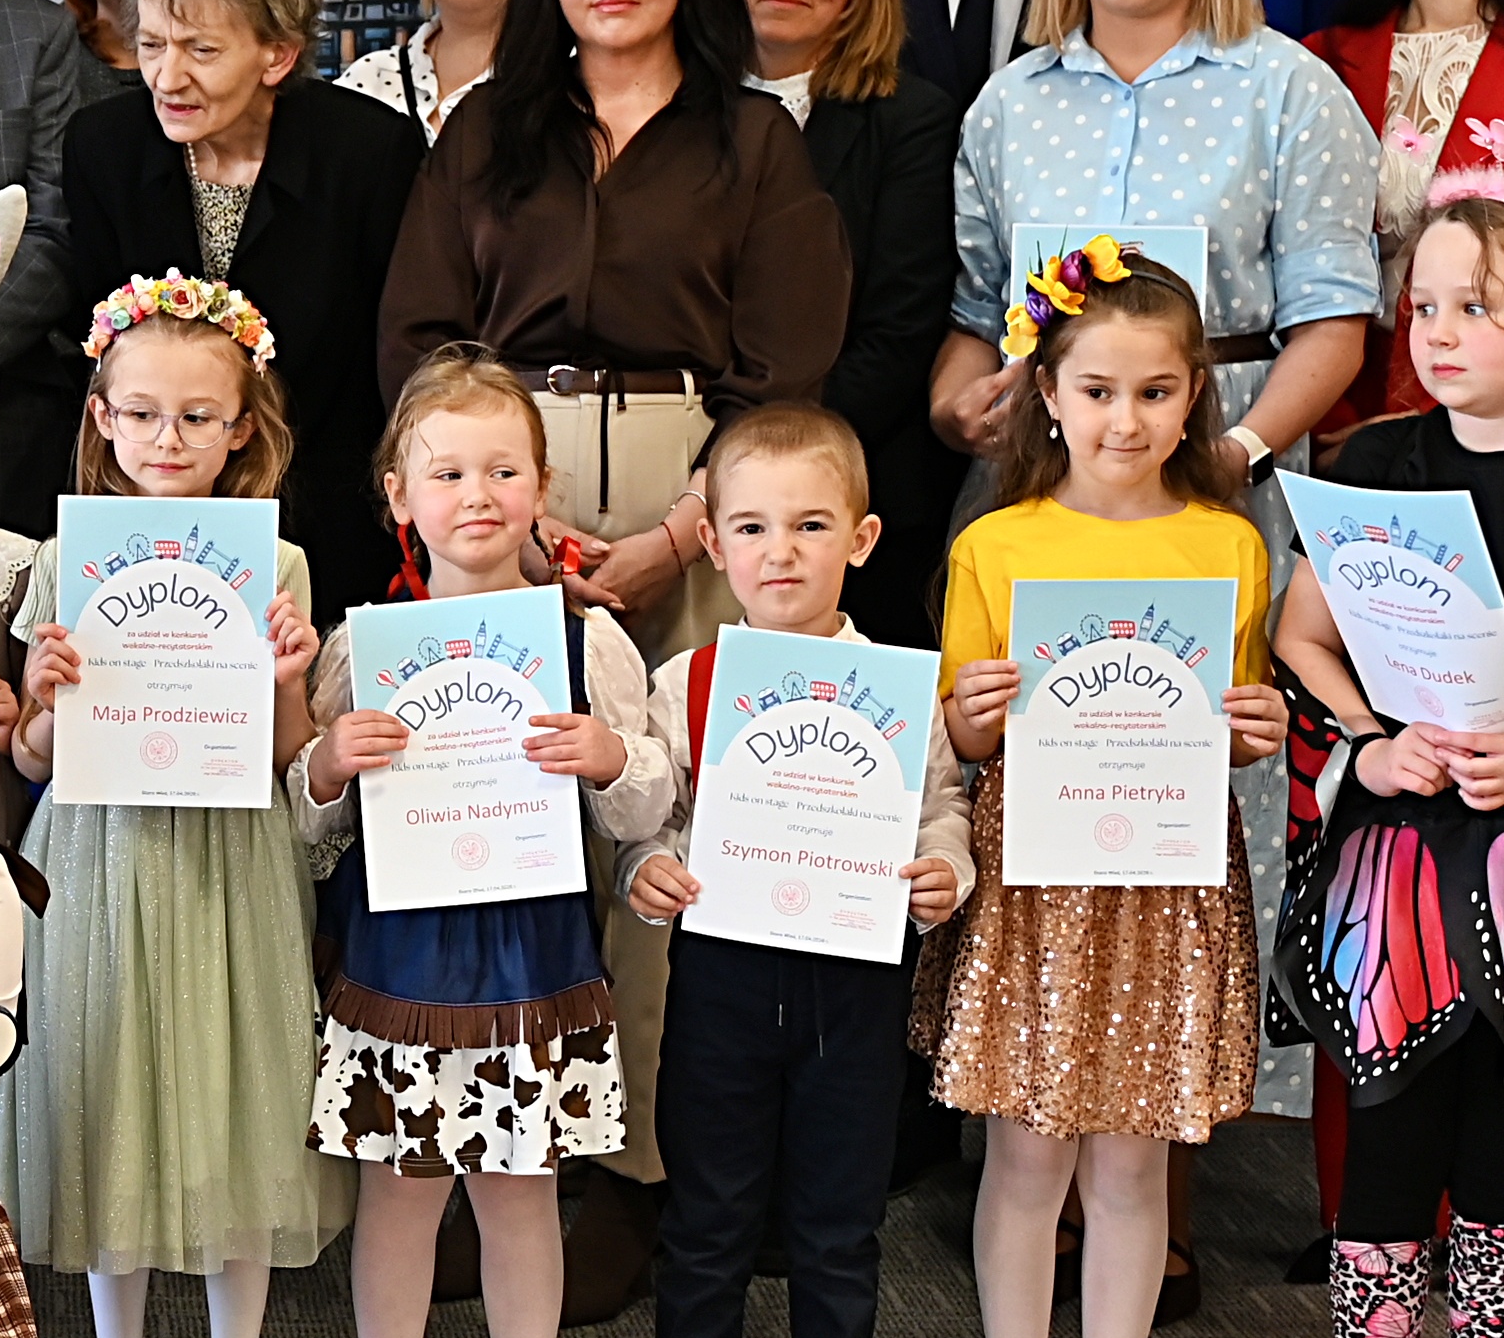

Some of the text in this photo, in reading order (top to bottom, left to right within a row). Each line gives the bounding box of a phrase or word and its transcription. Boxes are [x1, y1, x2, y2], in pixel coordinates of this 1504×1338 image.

[1339, 556, 1451, 607] Dyplom
[97, 573, 228, 630] Dyplom
[122, 642, 212, 651] wokalno-recytatorskim
[88, 658, 107, 666] Kids
[123, 660, 146, 670] stage
[154, 659, 214, 668] Przedszkolaki
[229, 661, 258, 669] scenie
[1385, 654, 1475, 685] Lena Dudek
[147, 682, 192, 692] otrzymuje
[1049, 652, 1182, 709] Dyplom
[395, 671, 522, 732] Dyplom
[92, 706, 248, 725] Maja Prodziewicz
[1074, 722, 1166, 731] wokalno-recytatorskim
[746, 716, 877, 778] Dyplom
[1039, 738, 1058, 747] Kids
[1075, 740, 1099, 750] stage
[1107, 738, 1168, 747] Przedszkolaki
[1184, 739, 1212, 747] scenie
[1098, 761, 1145, 771] otrzymuje
[452, 777, 497, 790] otrzymuje
[1058, 784, 1185, 803] Anna Pietryka
[406, 797, 548, 825] Oliwia Nadymus
[786, 823, 833, 837] otrzymuje
[721, 839, 893, 878] Szymon Piotrowski
